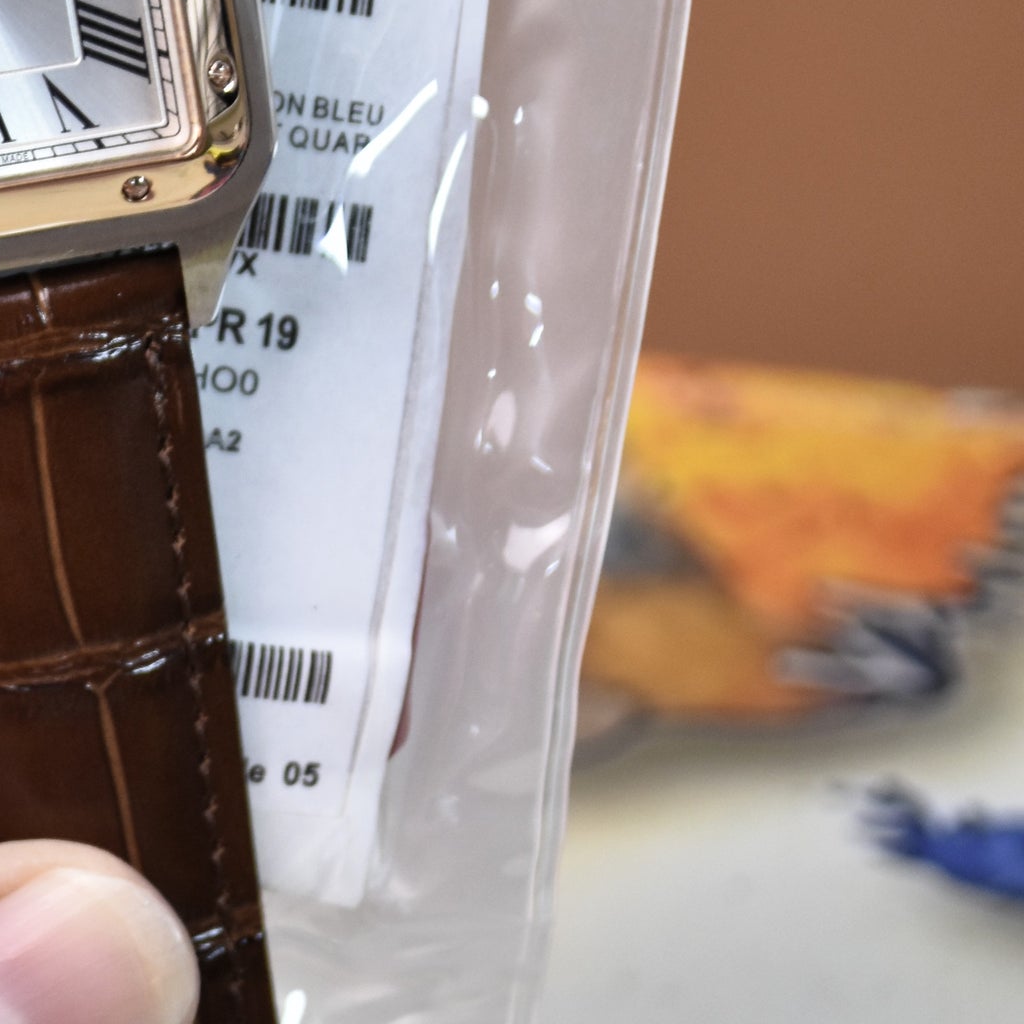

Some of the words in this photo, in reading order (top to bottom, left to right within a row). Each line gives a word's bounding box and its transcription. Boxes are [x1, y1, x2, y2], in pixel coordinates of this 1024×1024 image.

[312, 95, 385, 126] BLEU
[1, 151, 31, 164] MADE
[258, 311, 300, 351] 19
[283, 760, 321, 788] 05
